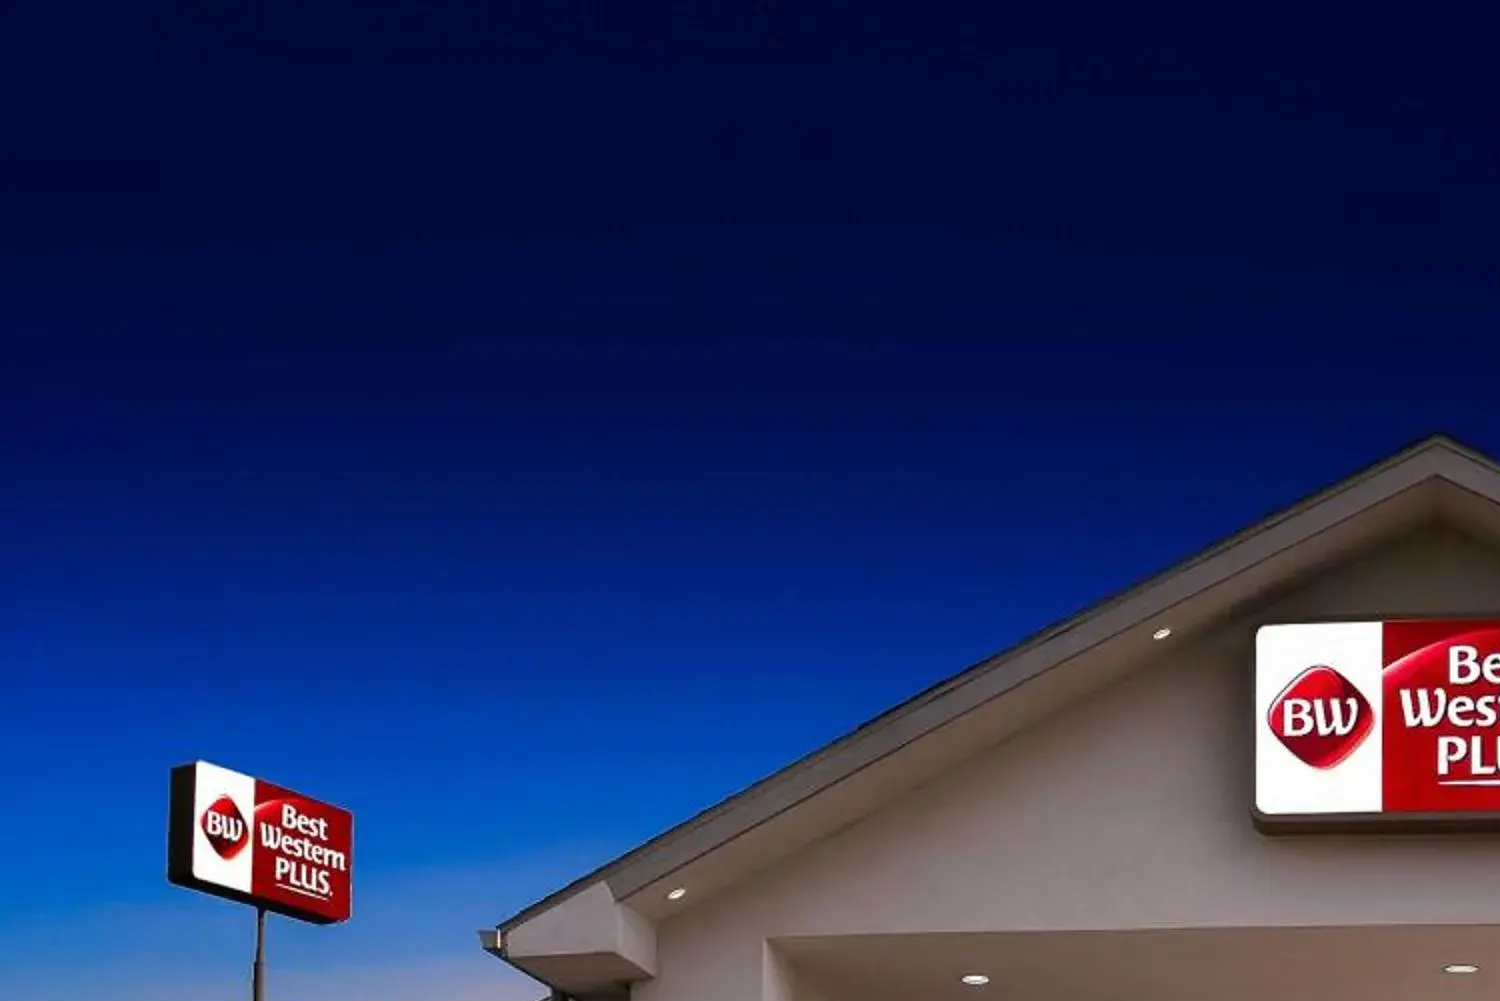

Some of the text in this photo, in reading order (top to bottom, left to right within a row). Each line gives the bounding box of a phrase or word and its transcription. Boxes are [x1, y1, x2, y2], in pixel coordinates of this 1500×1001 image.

[1282, 698, 1358, 737] BW
[207, 811, 243, 842] BW
[282, 803, 328, 841] Best
[260, 821, 346, 871] Western
